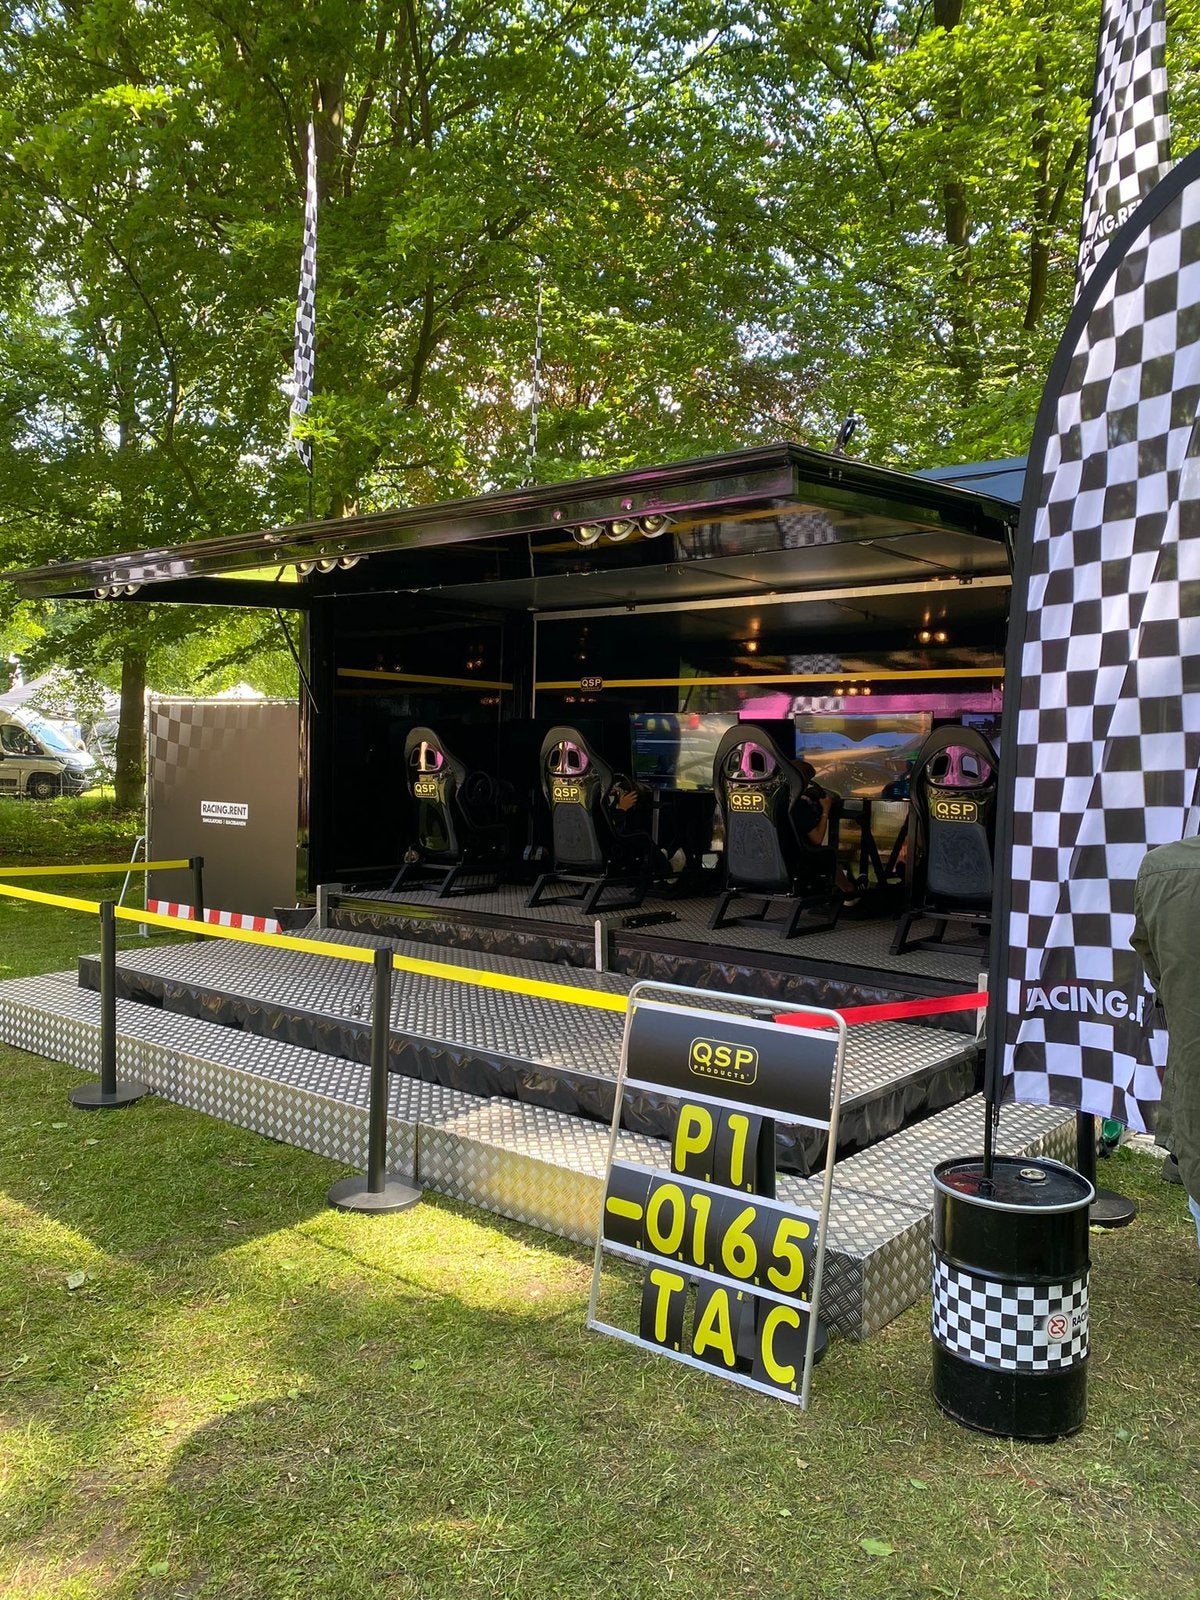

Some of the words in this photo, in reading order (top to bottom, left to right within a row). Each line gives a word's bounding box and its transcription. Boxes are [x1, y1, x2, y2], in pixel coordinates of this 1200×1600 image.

[581, 678, 601, 688] QSP
[415, 784, 435, 794] QSP
[554, 787, 578, 798] QSP
[732, 794, 762, 806] QSP
[203, 803, 246, 815] RACING.RENT
[937, 802, 974, 815] QSP
[693, 1042, 754, 1070] QSP
